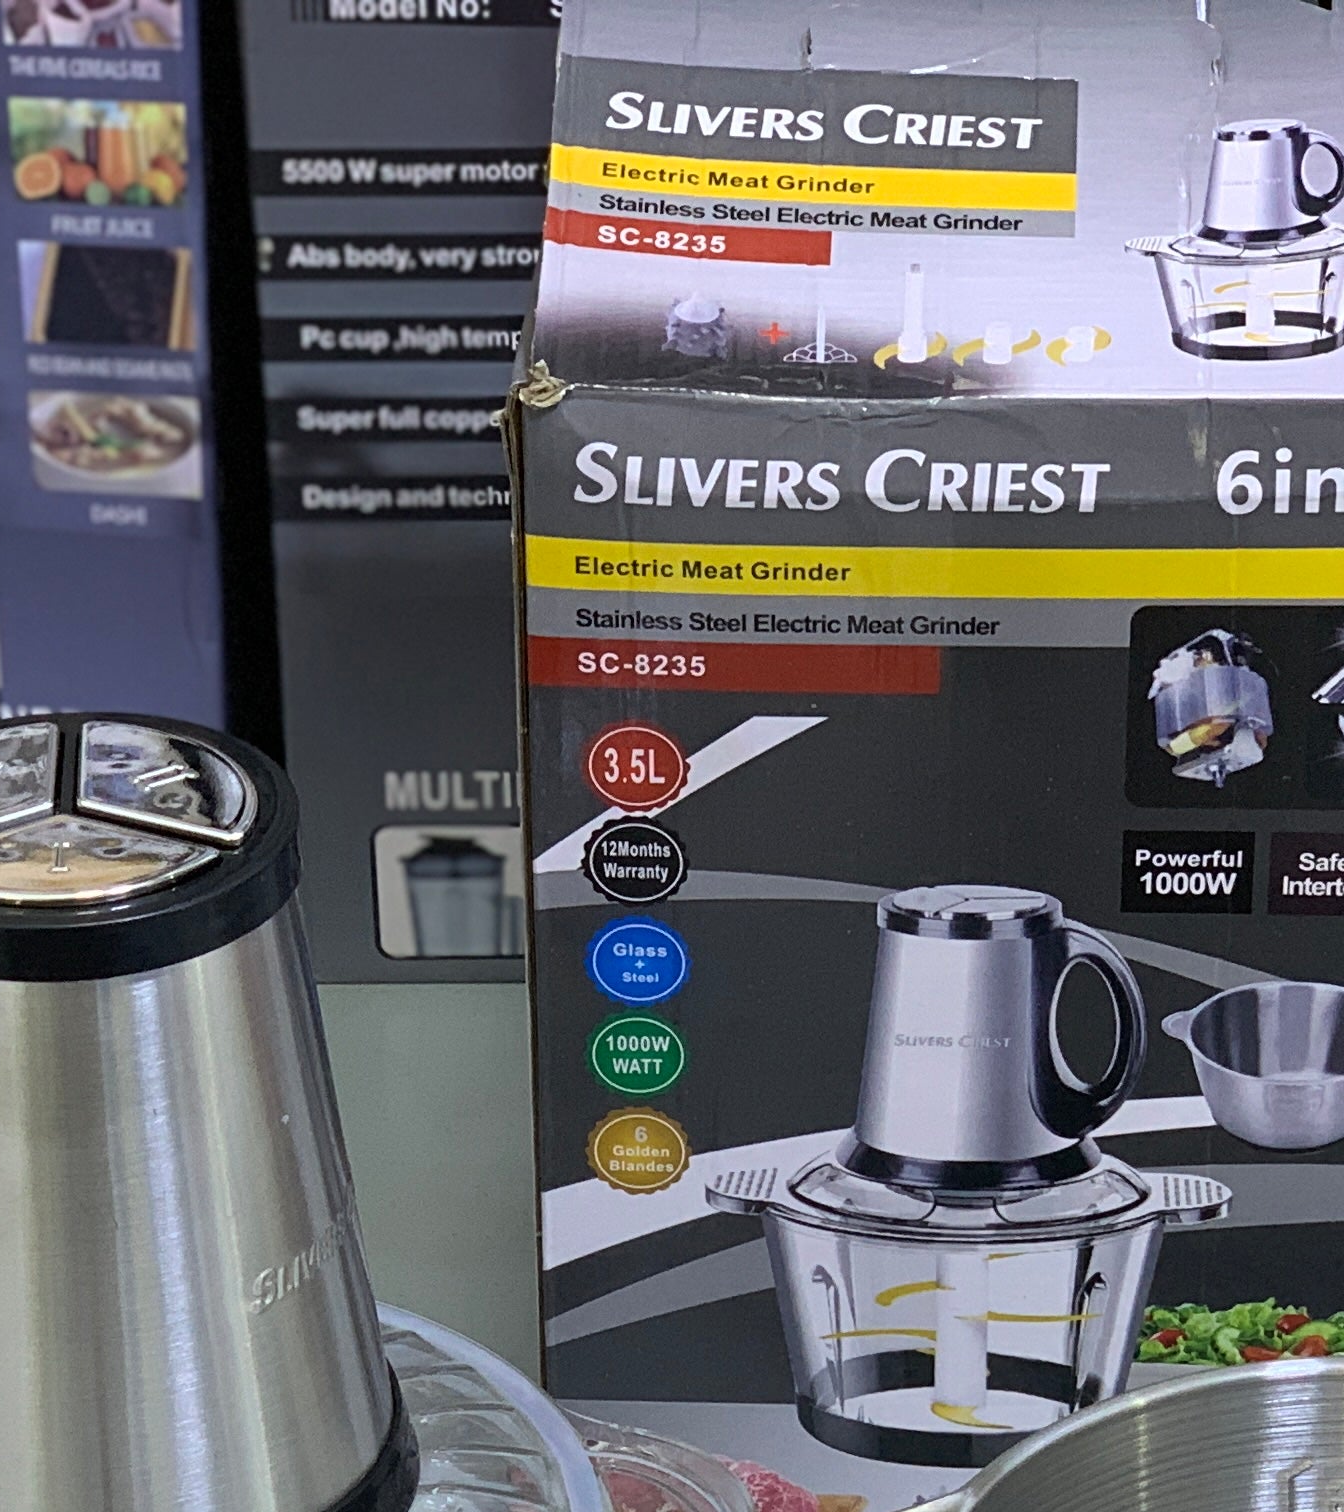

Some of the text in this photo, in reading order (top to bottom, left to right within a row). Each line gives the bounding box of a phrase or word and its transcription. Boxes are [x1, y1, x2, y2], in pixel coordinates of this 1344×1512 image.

[329, 0, 489, 17] Model No:
[605, 90, 1042, 147] SLIVERS CRIEST
[281, 159, 537, 184] 5500 W super motor
[601, 163, 874, 193] Electric Meat Grinder
[599, 193, 1022, 230] Stainless Steel Electric Meat Grinder
[597, 225, 725, 251] SC-8235
[287, 245, 539, 270] Abs body, very stro
[300, 328, 334, 348] Pc
[340, 333, 387, 352] cup
[298, 408, 499, 432] Super full coppe
[573, 441, 1110, 511] SLIVERS CRIEST
[303, 485, 390, 511] Design
[396, 485, 442, 505] and
[574, 556, 851, 580] Electric Meat Grinder
[575, 607, 999, 634] Stainless Steel Electric Meat Grinder
[577, 651, 706, 675] SC-8235
[604, 748, 664, 783] 3.5L
[601, 841, 670, 856] 12Months
[1135, 850, 1242, 866] Powerful
[603, 862, 667, 881] Warranty
[1140, 872, 1235, 893] 1000W
[613, 942, 667, 956] Glass
[622, 972, 659, 983] Steel
[606, 1035, 669, 1051] 1000W
[894, 1034, 952, 1046] SLIVERS
[612, 1057, 662, 1073] WATT
[635, 1125, 646, 1141] 6
[612, 1145, 669, 1156] Golden
[609, 1160, 673, 1172] Blandes
